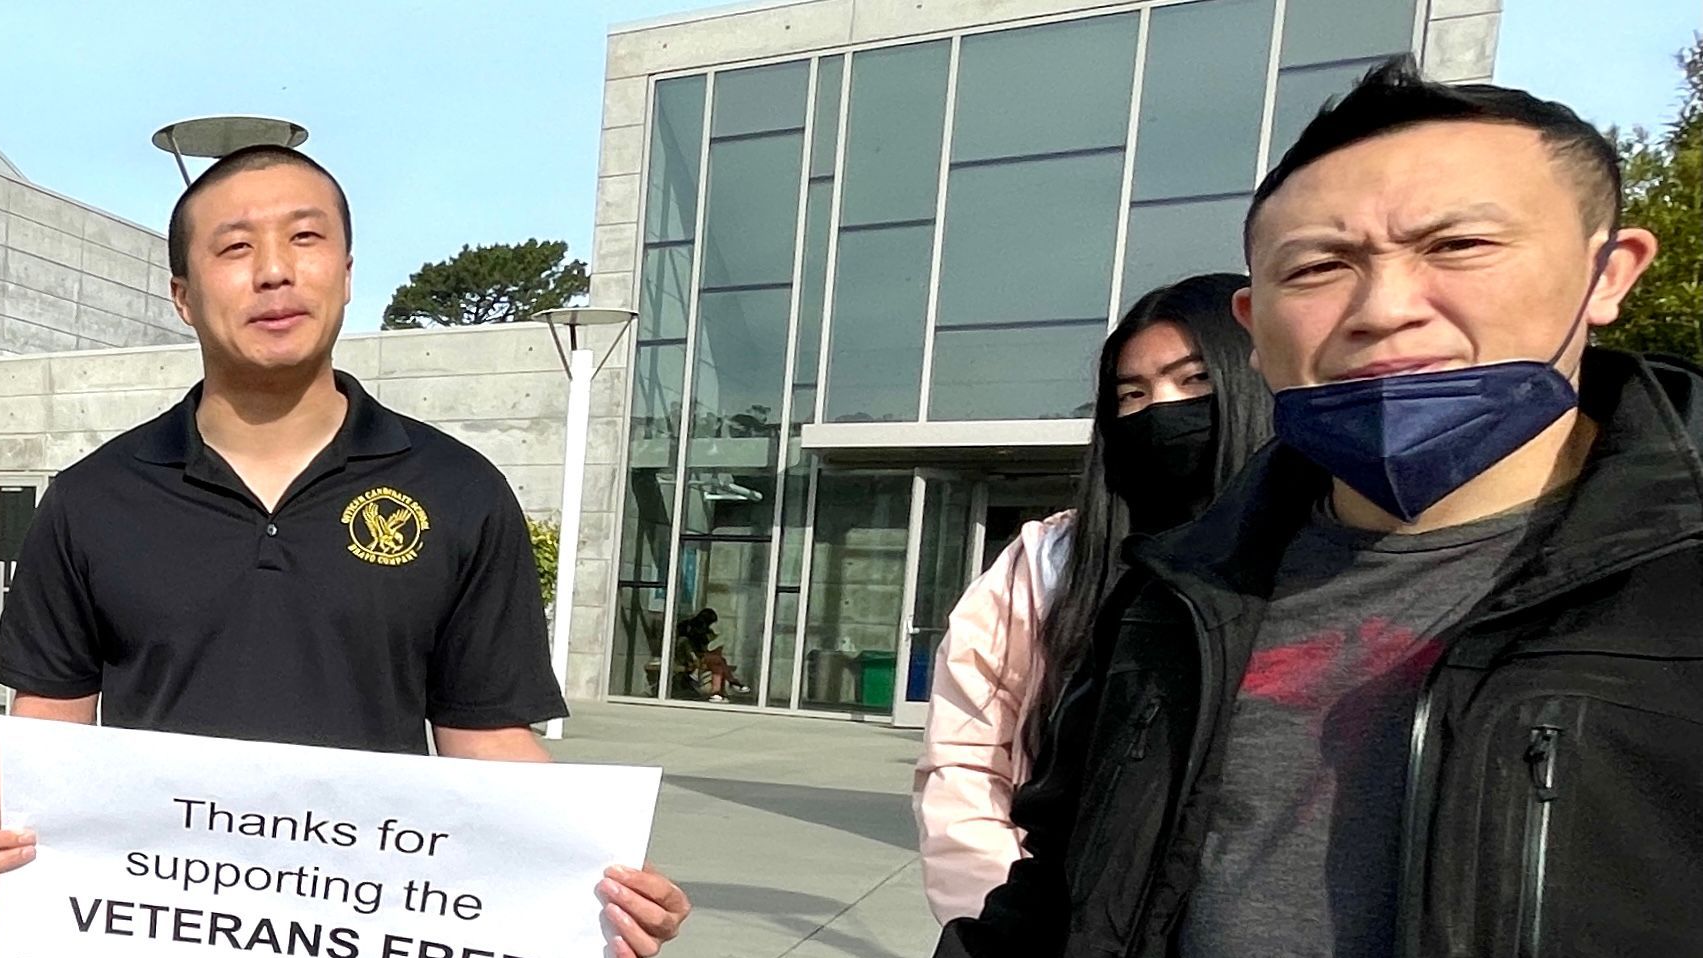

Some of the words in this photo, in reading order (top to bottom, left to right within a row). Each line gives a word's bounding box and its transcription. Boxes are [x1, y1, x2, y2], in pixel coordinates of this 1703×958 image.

[173, 798, 357, 847] Thanks
[379, 819, 449, 857] for
[126, 850, 384, 914] supporting
[403, 881, 483, 920] the
